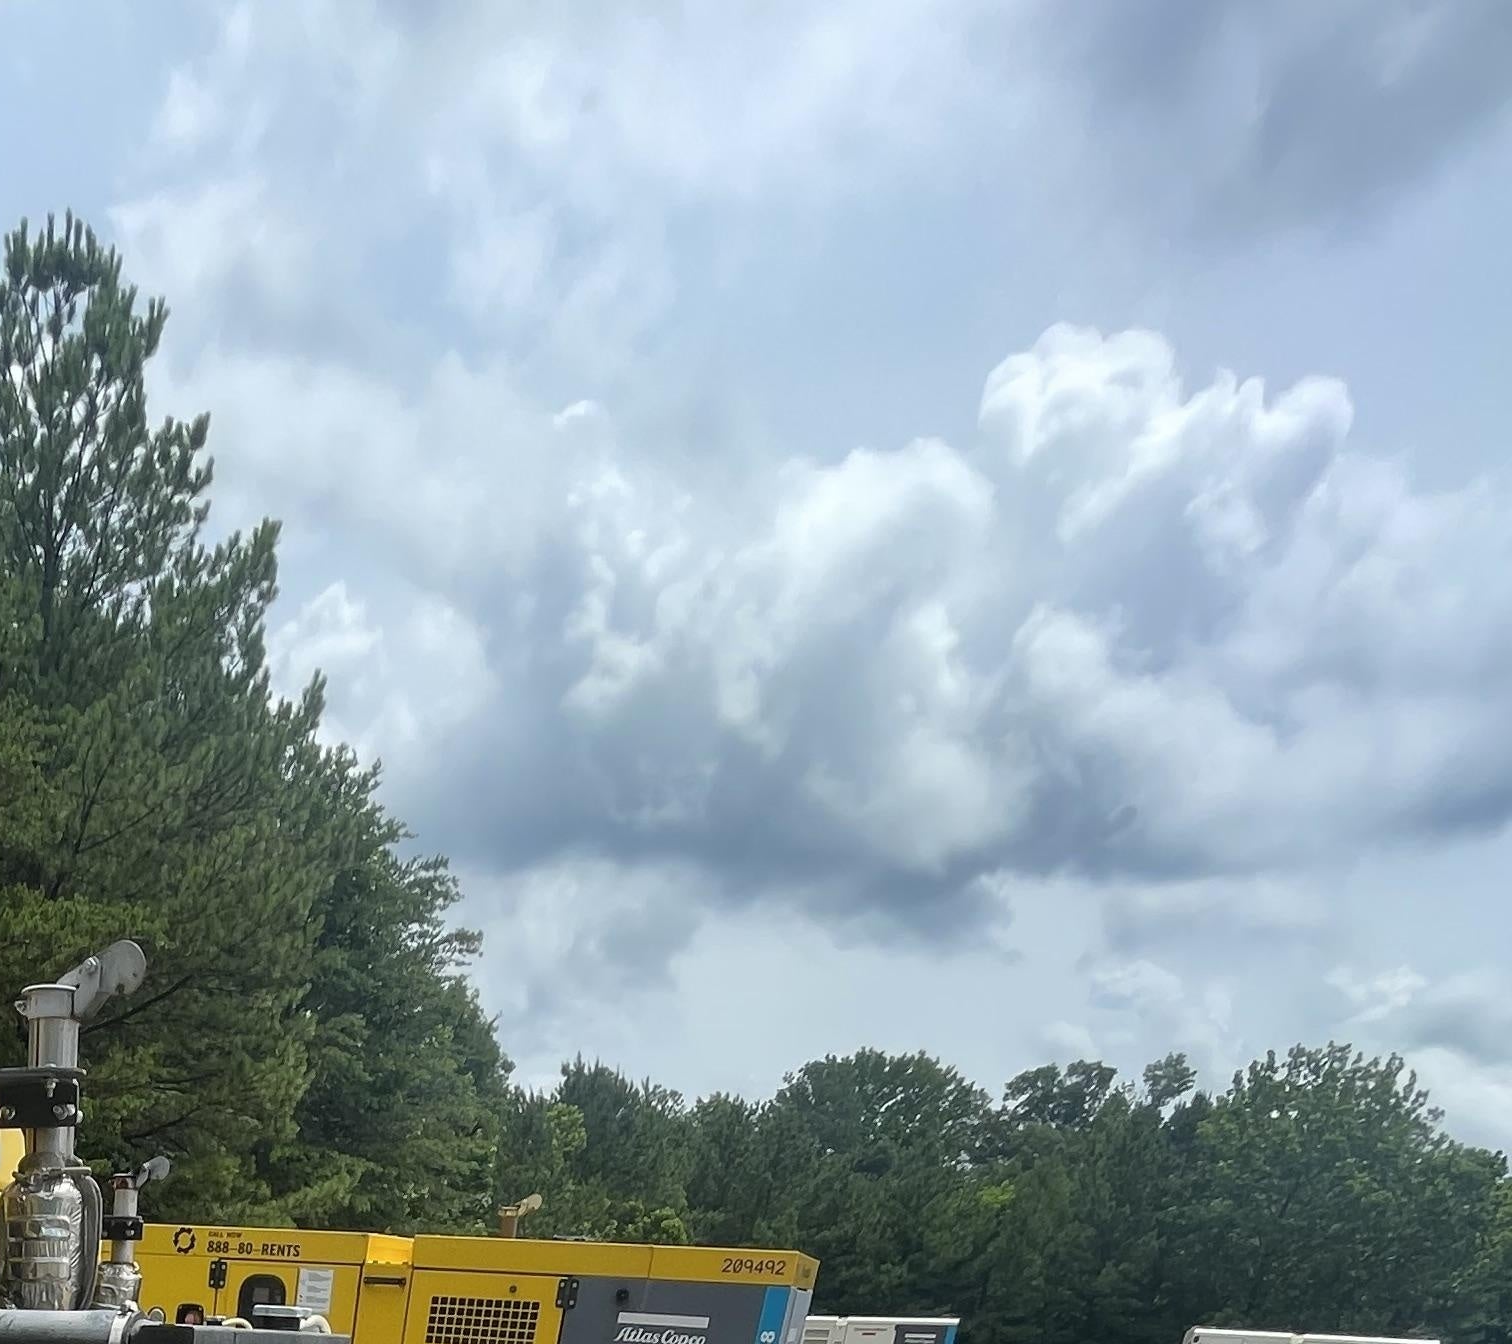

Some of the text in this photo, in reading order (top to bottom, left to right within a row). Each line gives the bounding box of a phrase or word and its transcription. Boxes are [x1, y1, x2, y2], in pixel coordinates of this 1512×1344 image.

[208, 1230, 243, 1239] CALL NOW
[206, 1240, 301, 1258] 888-80-RENTS
[721, 1258, 786, 1276] 209492
[613, 1326, 660, 1344] Atlas
